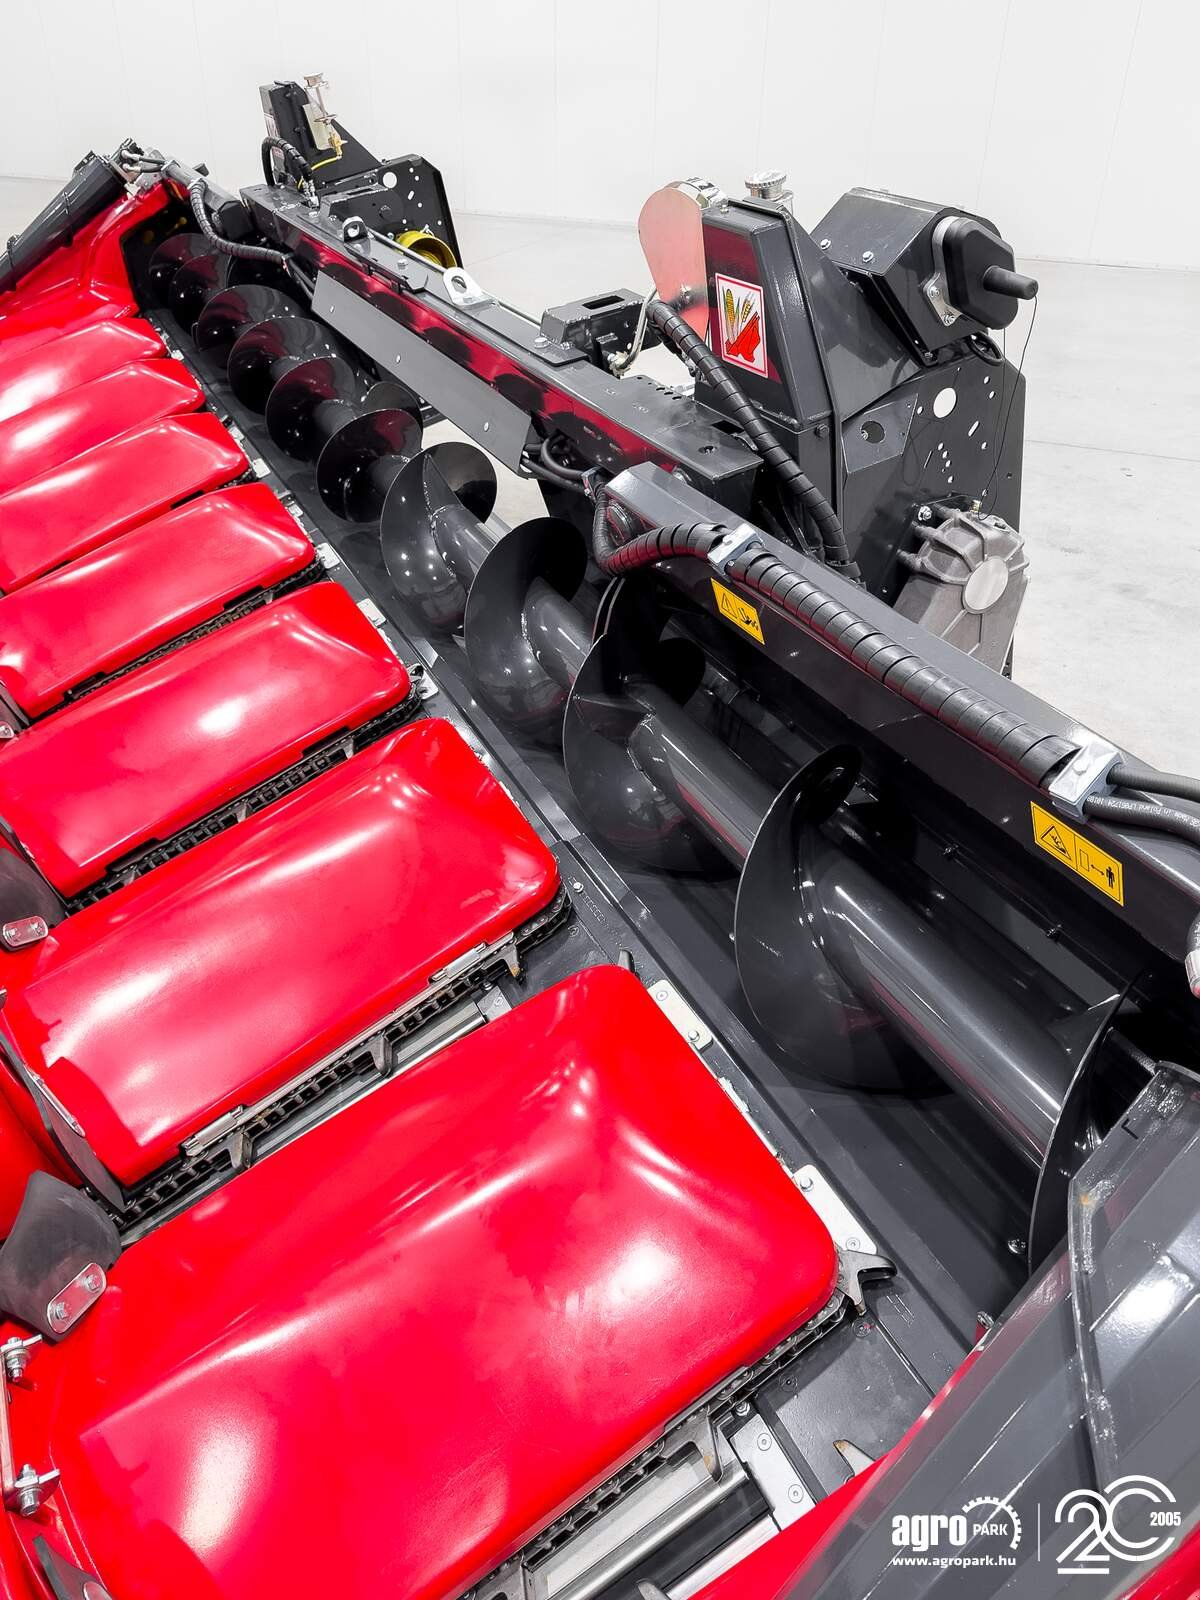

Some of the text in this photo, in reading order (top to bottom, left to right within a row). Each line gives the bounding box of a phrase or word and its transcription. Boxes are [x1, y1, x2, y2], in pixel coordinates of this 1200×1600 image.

[1138, 804, 1161, 815] Poland
[1163, 808, 1172, 816] in
[1174, 811, 1190, 822] Made
